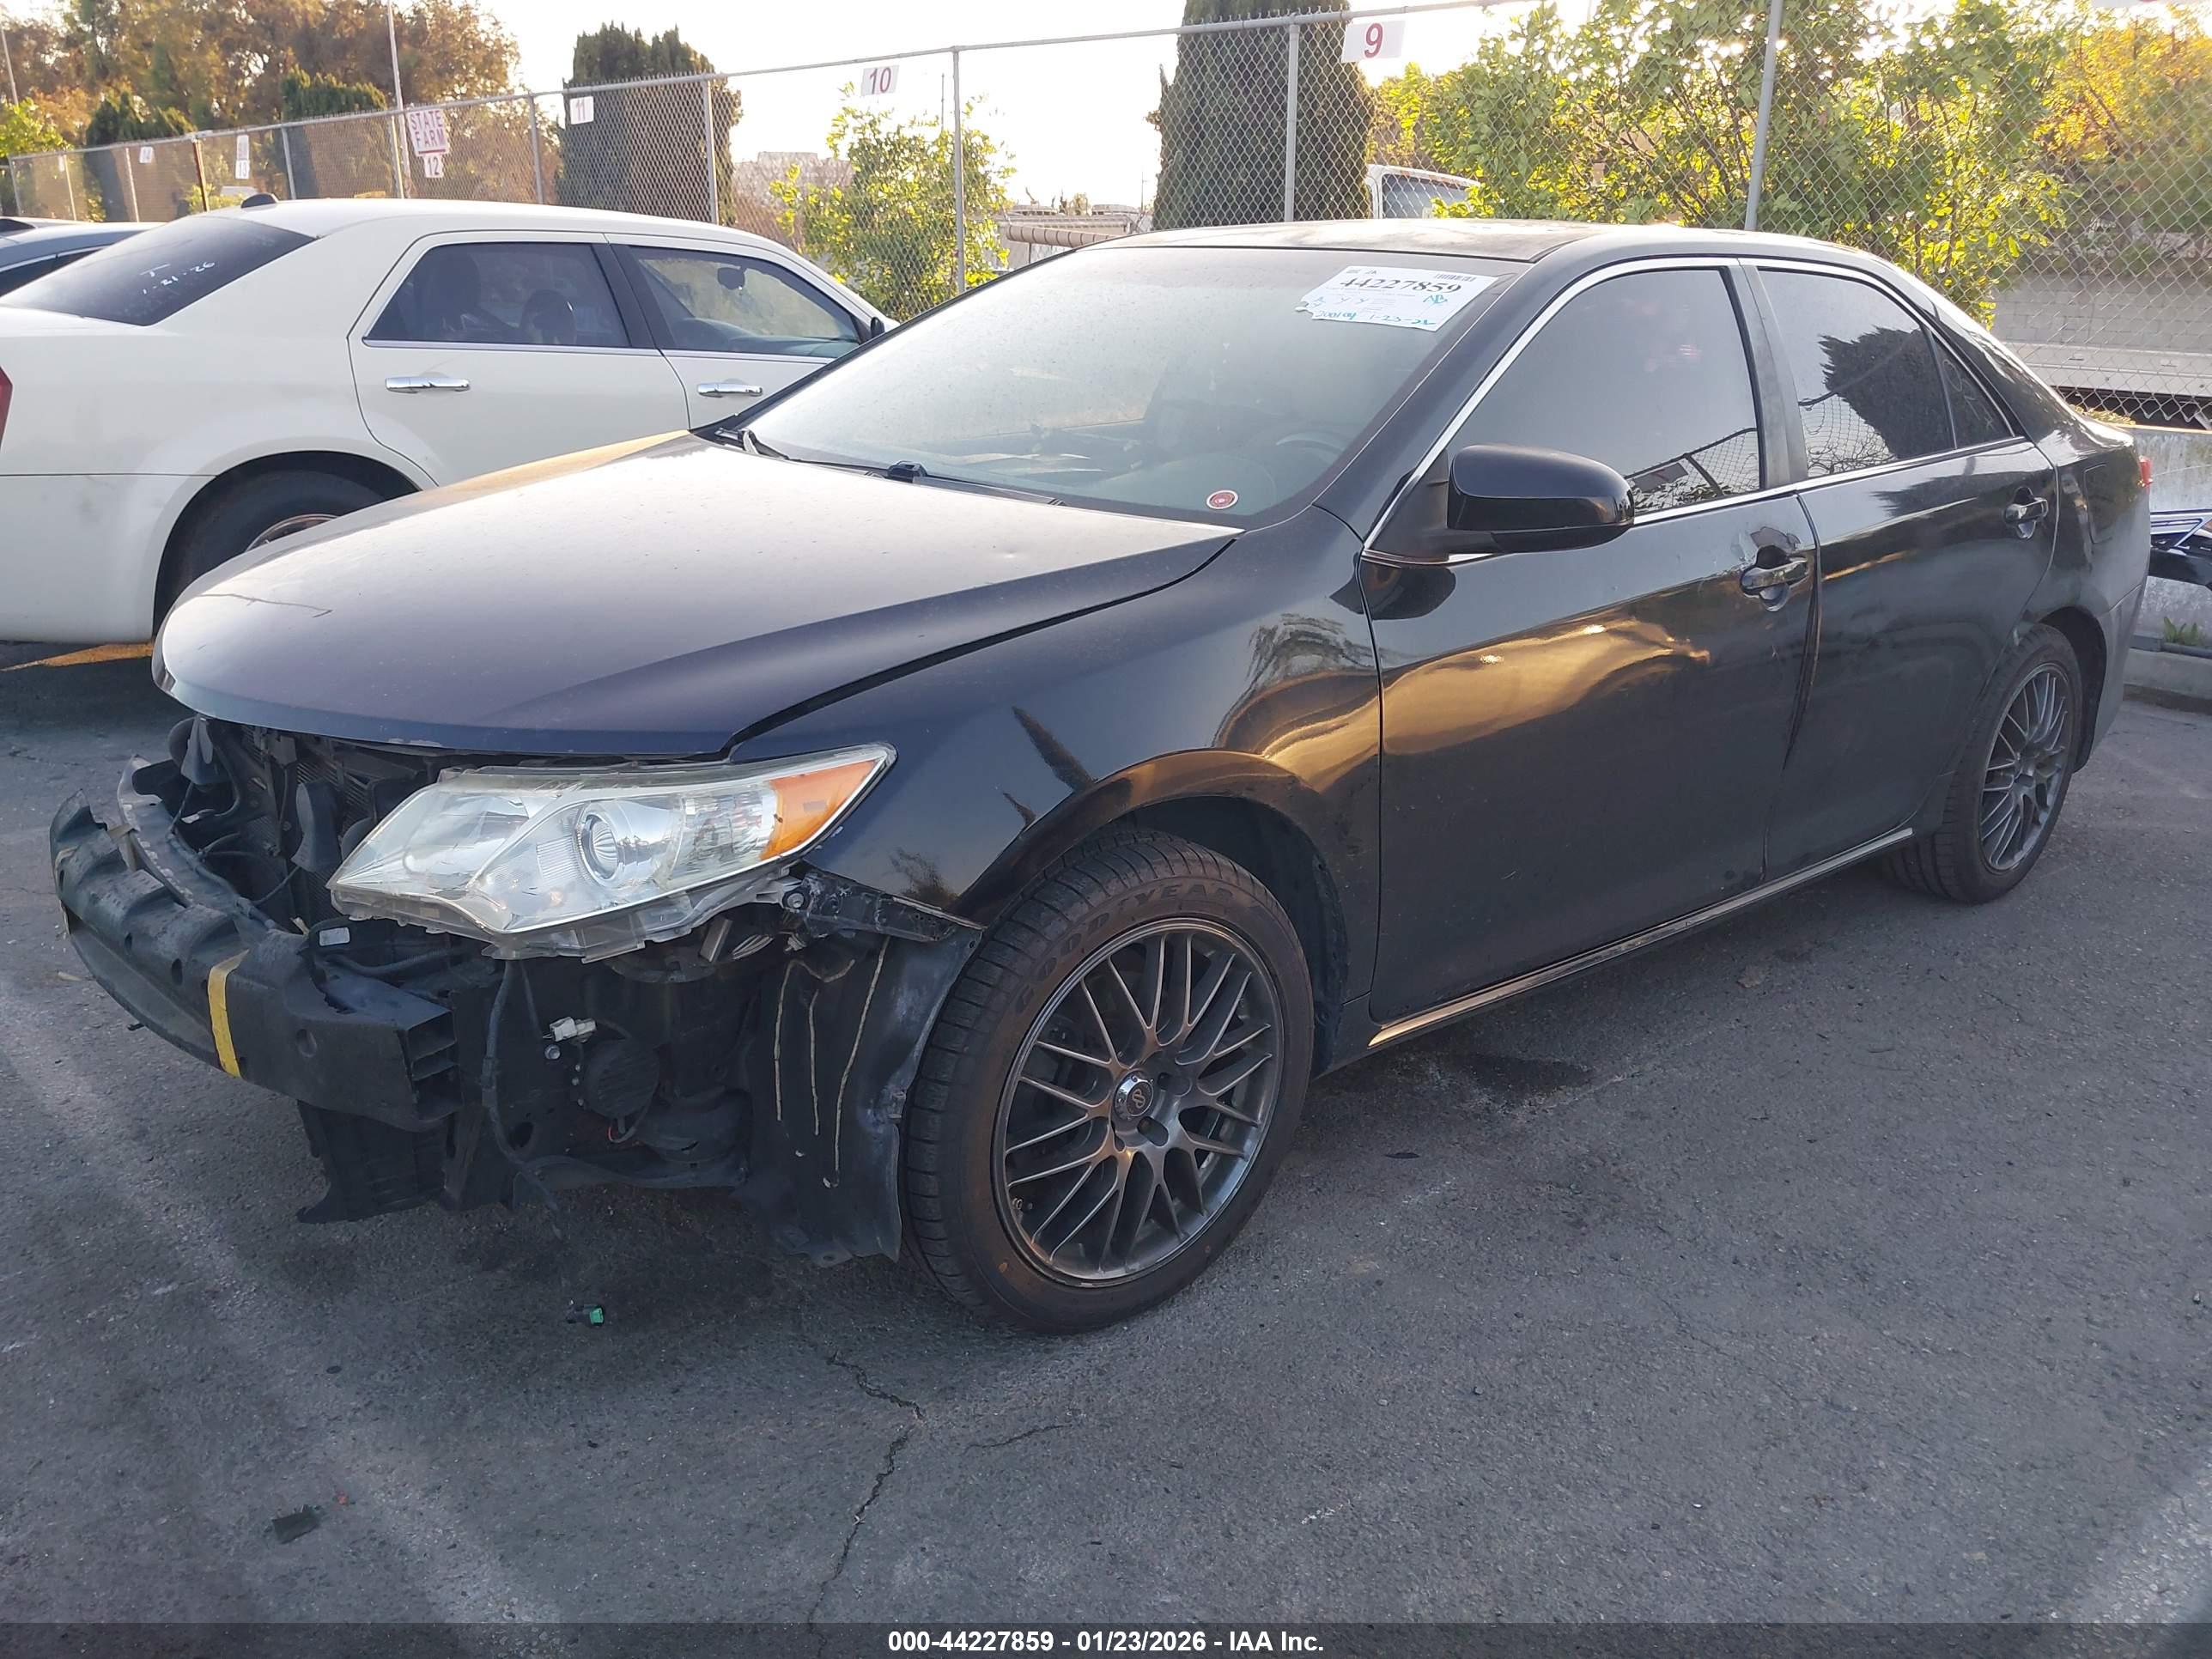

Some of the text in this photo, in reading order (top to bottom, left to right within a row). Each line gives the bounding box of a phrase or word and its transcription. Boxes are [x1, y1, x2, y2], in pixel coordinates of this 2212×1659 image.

[1364, 22, 1383, 59] 9
[869, 67, 891, 94] 10
[410, 110, 443, 131] STATE
[576, 99, 586, 122] 11
[415, 127, 446, 148] FARM
[428, 156, 441, 176] 12
[1340, 277, 1462, 294] 44227859
